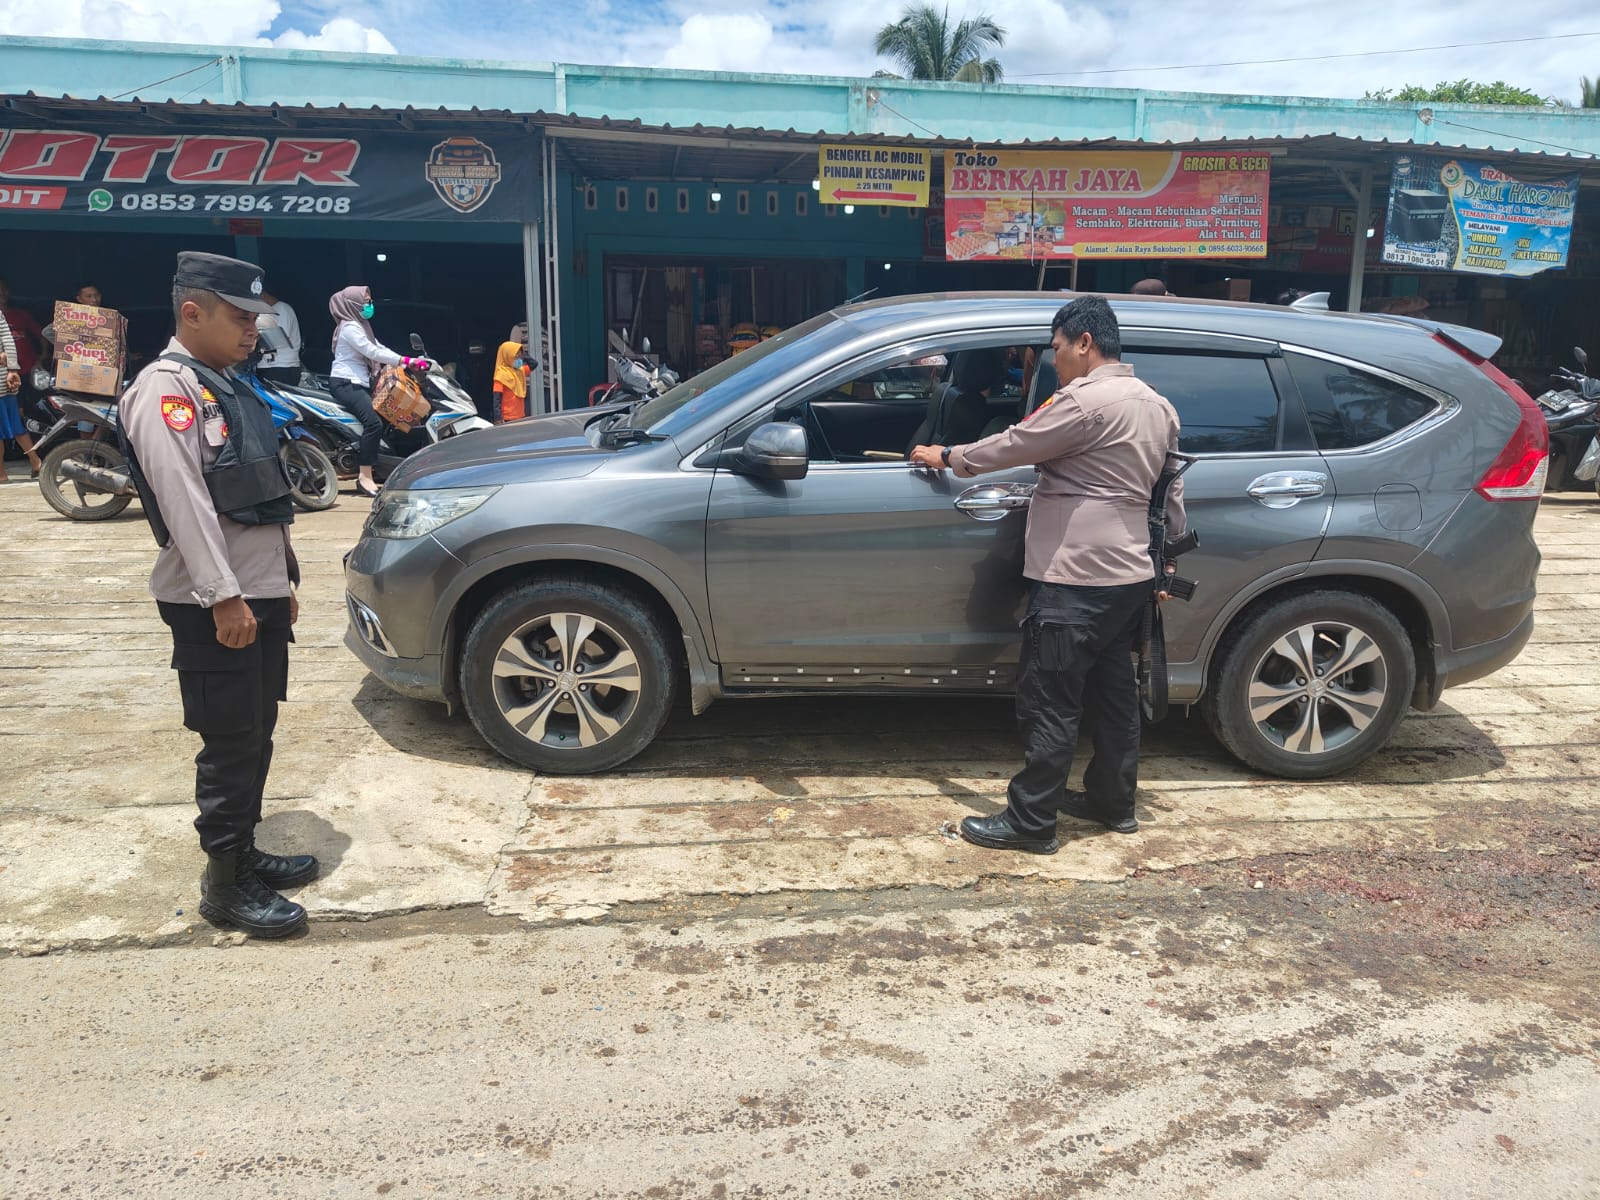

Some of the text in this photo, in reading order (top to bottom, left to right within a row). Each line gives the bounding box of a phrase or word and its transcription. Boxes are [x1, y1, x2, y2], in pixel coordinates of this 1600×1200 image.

[0, 129, 361, 187] OTOR
[826, 149, 924, 164] BENGKEL AC MOBIL
[954, 152, 998, 166] Toko
[1183, 156, 1268, 171] GROSIR & ECER
[824, 166, 925, 182] PINDAH KESAMPING
[951, 168, 1142, 192] BERKAH JAYA
[863, 182, 871, 190] 25
[873, 183, 892, 191] METER
[1463, 180, 1504, 202] DARUL
[121, 193, 351, 214] 0853 7994 7208
[1219, 194, 1257, 205] Menjual
[1072, 206, 1108, 216] Macam
[1117, 206, 1152, 216] Macam
[1155, 206, 1208, 216] Kebutuhan
[1210, 206, 1262, 216] Sehari-hari
[1076, 218, 1261, 229] Sembako, Elektronik, Busa, Furniture,
[1468, 222, 1501, 232] MELAYANI
[1199, 229, 1261, 240] Alat Tulis, dll
[1085, 245, 1109, 253] Alamat
[1115, 245, 1133, 253] Jalan
[1135, 245, 1151, 254] Raya
[1484, 247, 1502, 257] PLUS
[1531, 251, 1563, 262] PESAWAT
[1386, 252, 1405, 261] 0813
[1408, 255, 1424, 264] 1080
[1426, 258, 1444, 266] 5651
[62, 307, 106, 328] Tango
[64, 341, 109, 362] Tango
